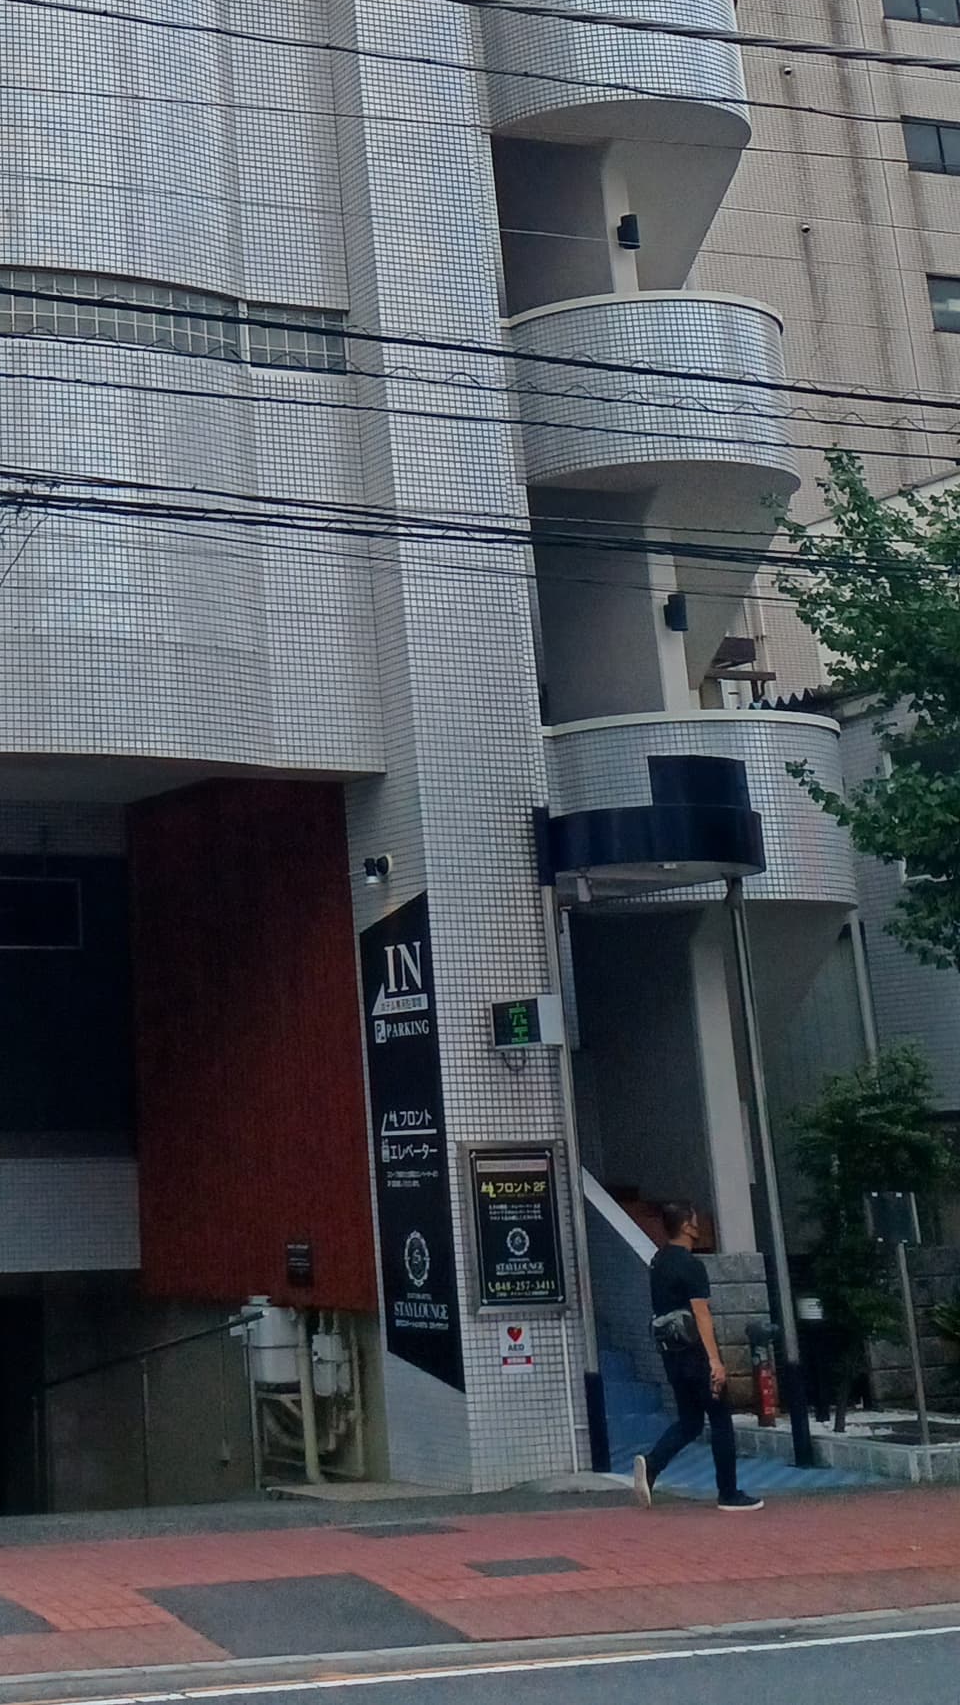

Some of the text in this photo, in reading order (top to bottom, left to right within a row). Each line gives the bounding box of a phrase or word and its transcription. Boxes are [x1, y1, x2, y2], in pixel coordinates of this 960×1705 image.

[383, 941, 422, 993] IN
[386, 1020, 430, 1037] PARKING
[400, 1108, 432, 1126] フロント
[390, 1143, 438, 1160] エレベーター
[507, 1343, 525, 1351] AED
